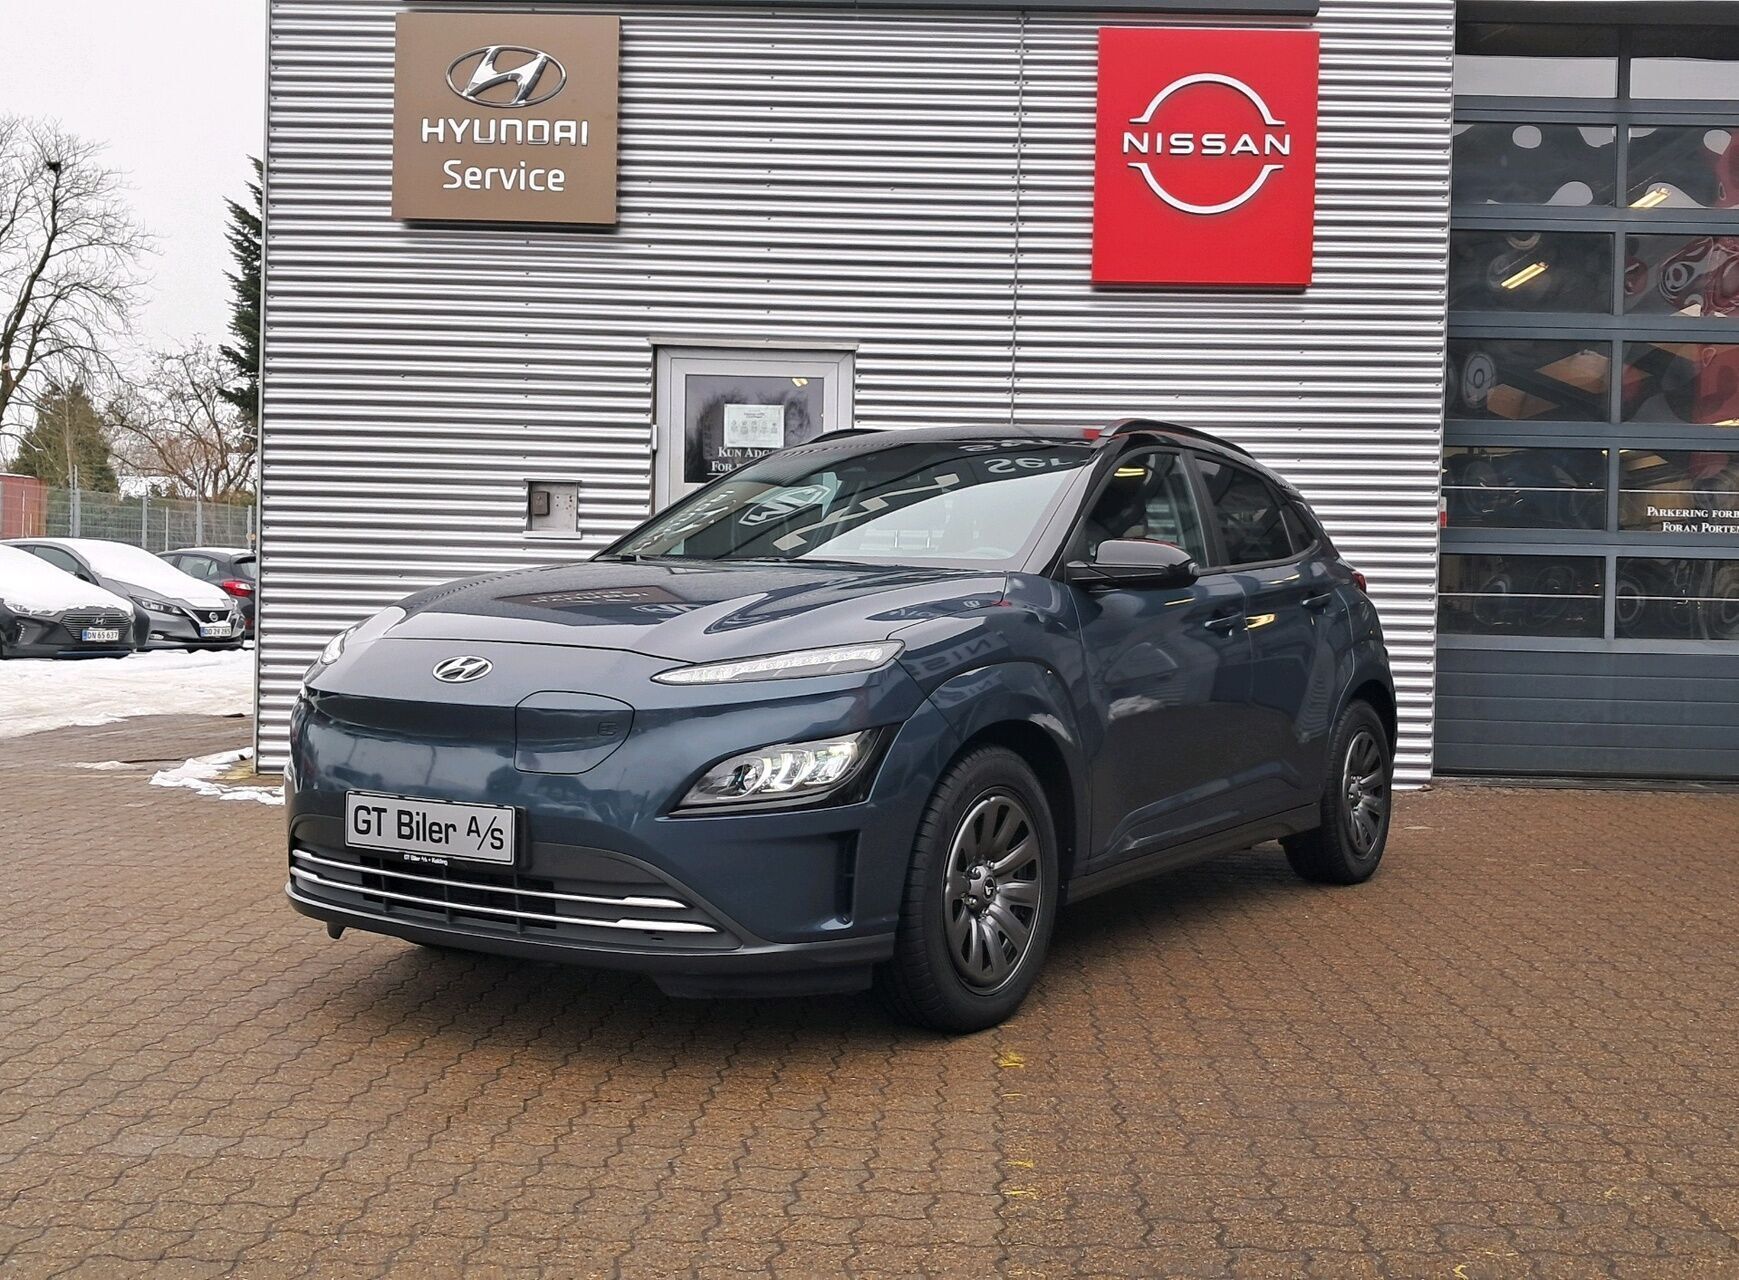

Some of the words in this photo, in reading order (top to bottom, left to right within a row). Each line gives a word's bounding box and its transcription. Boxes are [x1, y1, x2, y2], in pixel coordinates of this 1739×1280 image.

[421, 117, 589, 146] HYUNDAI
[1122, 132, 1291, 155] NISSAN
[442, 159, 566, 192] Service
[87, 631, 97, 639] DN
[353, 804, 388, 837] GT
[397, 809, 458, 845] Biler
[466, 815, 504, 851] A/S
